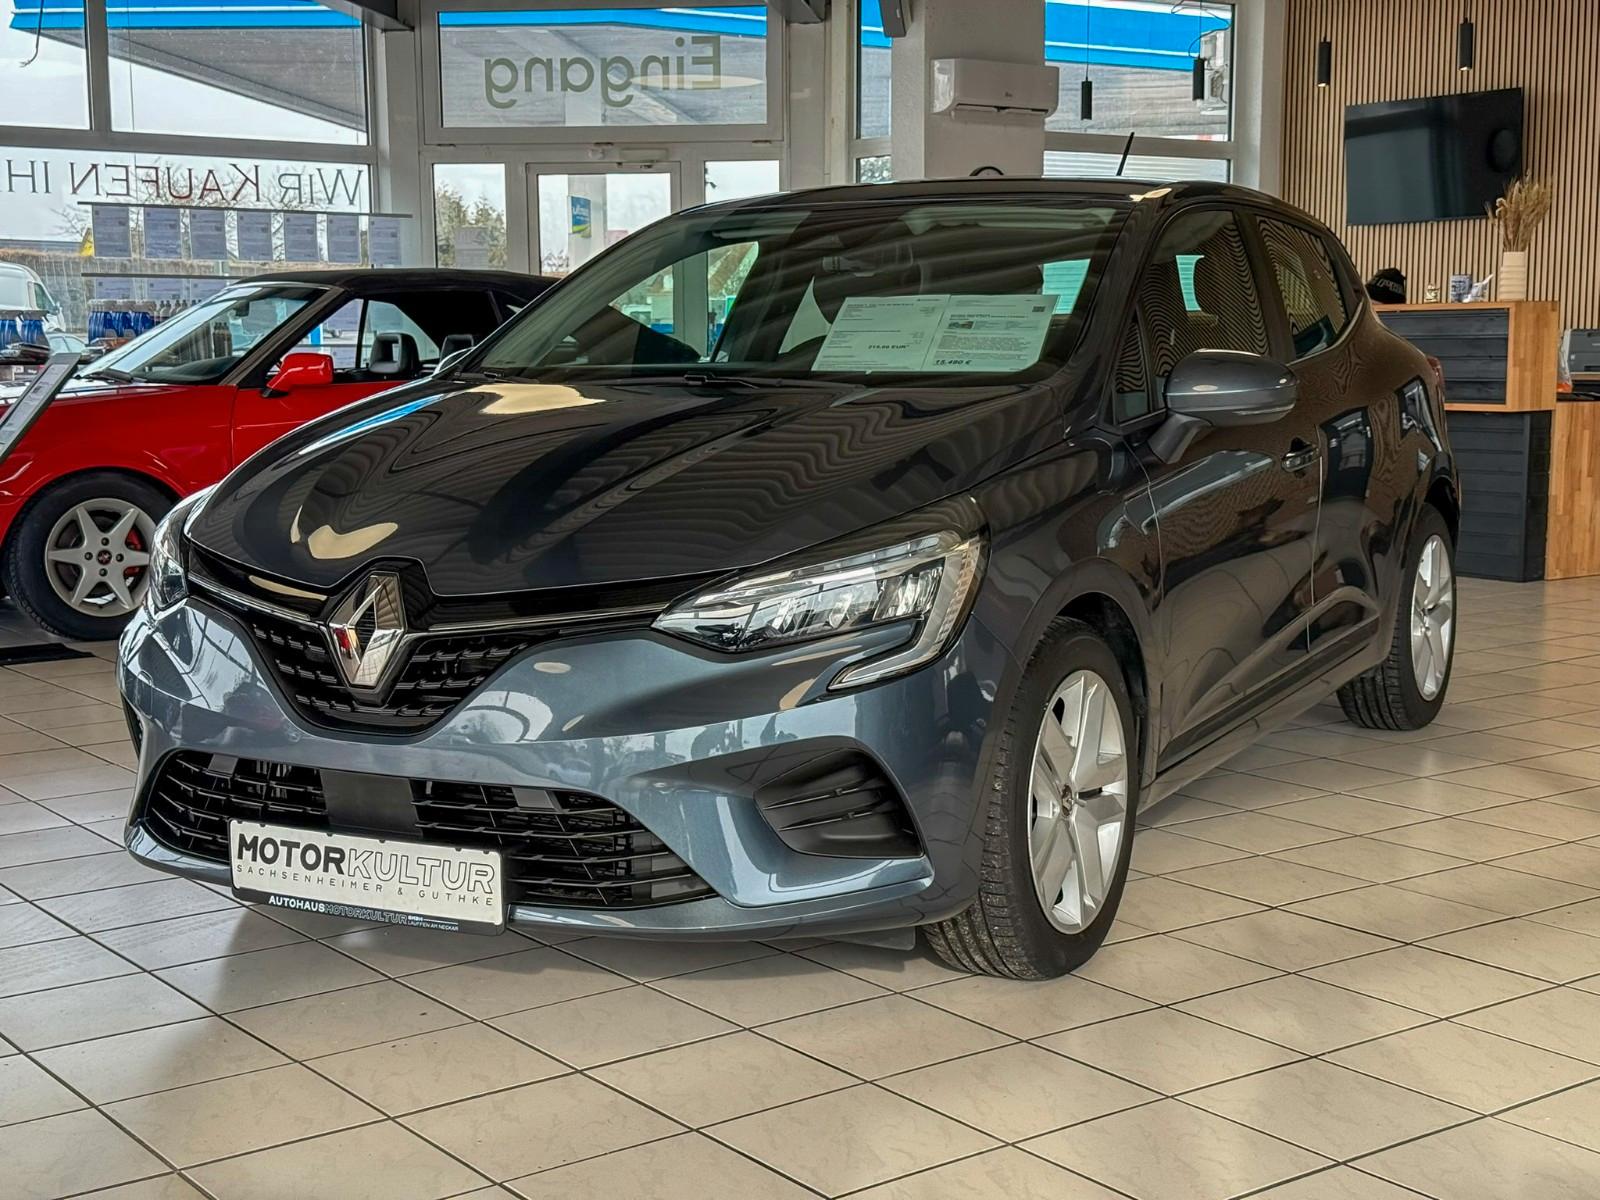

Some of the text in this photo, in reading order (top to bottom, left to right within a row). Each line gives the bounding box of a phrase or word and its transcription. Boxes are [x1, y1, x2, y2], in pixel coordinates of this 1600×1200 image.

[238, 833, 495, 894] MOTORKULTUR
[237, 866, 493, 906] SACHSENHEIMER & GUTHKE
[408, 920, 430, 928] LAUFFEN
